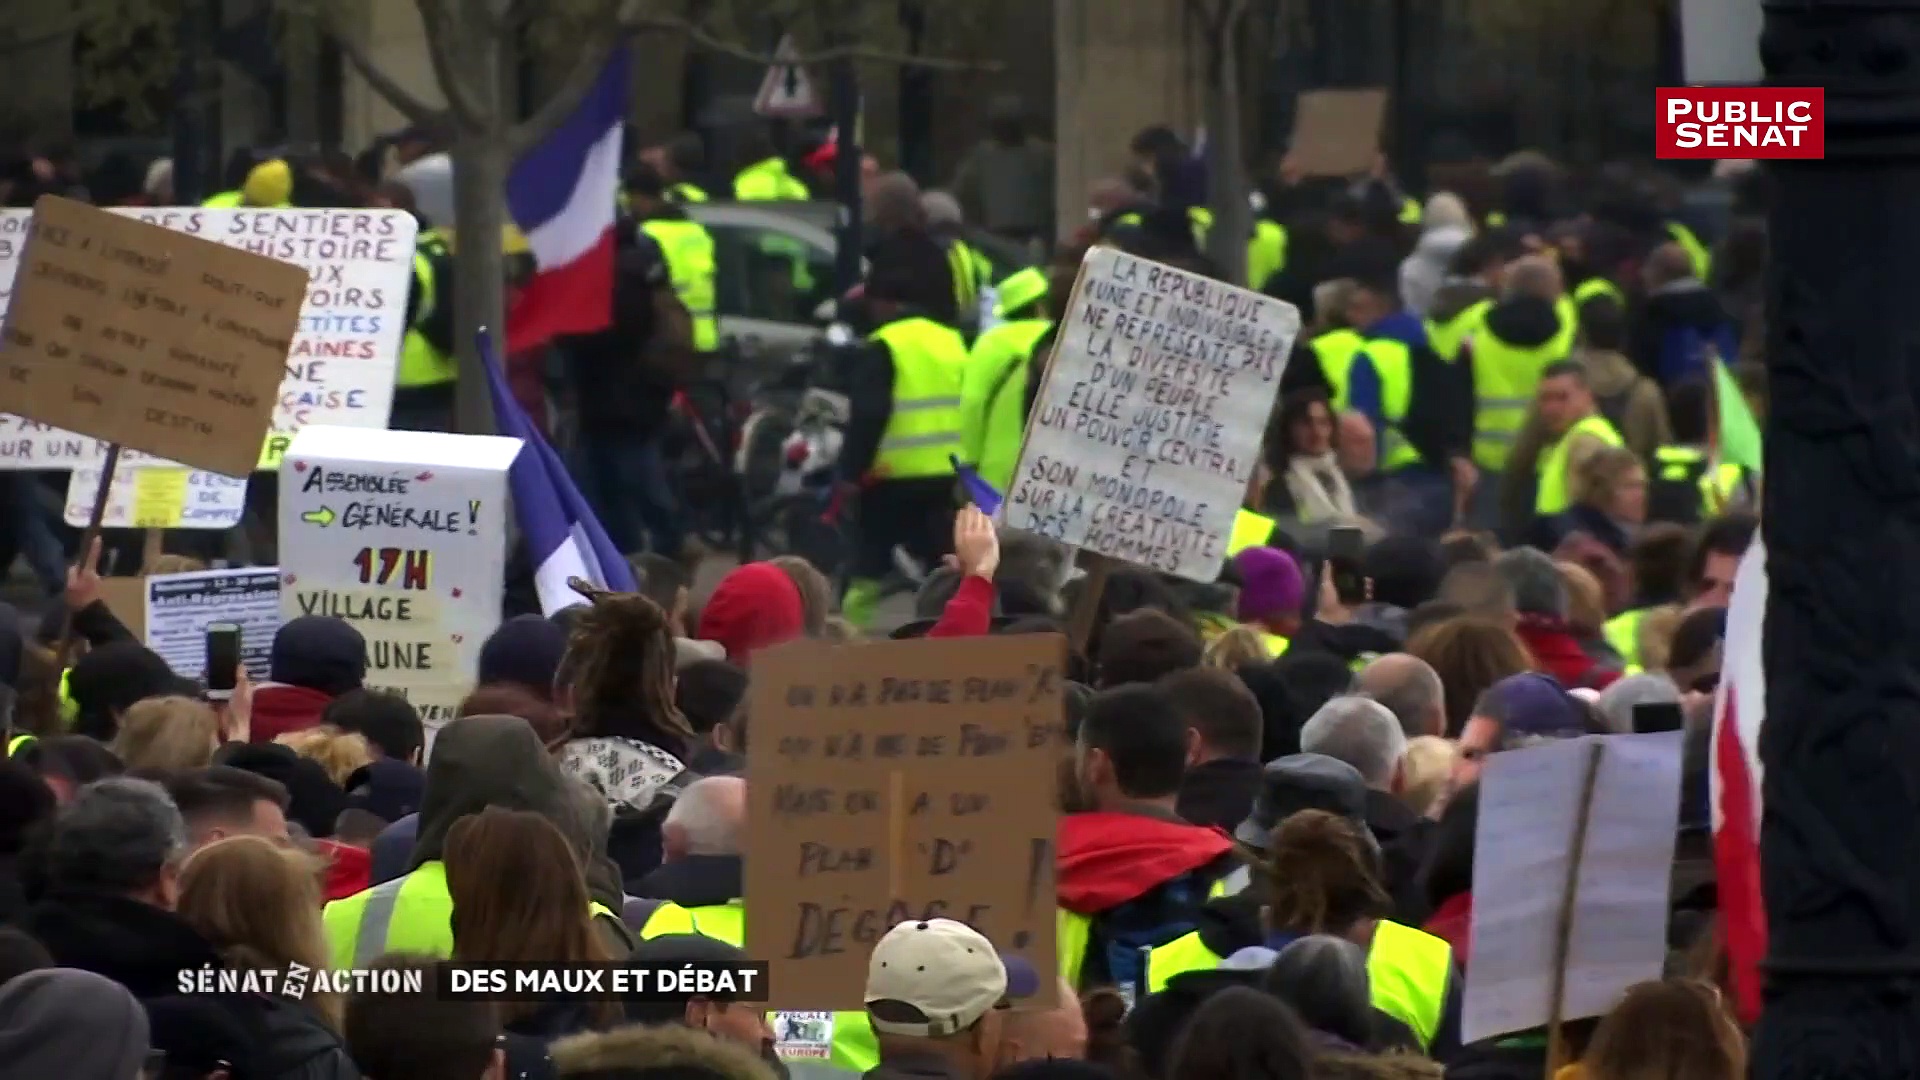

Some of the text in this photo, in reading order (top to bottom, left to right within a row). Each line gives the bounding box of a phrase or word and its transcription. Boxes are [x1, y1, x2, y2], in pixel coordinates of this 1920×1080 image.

[229, 209, 394, 235] SENTIERS
[1112, 255, 1137, 281] LA
[311, 287, 384, 309] OIRS
[1134, 291, 1163, 318] ET
[295, 336, 376, 359] AINES
[1083, 304, 1109, 330] NE
[1241, 348, 1280, 382] PAS
[1087, 334, 1112, 361] LA
[1145, 377, 1219, 417] PEUPLE
[1068, 381, 1225, 449] ELLE JUSTIFIE
[47, 439, 81, 457] UN
[1040, 405, 1069, 431] UN
[1158, 438, 1245, 484] CENTRAL
[1121, 454, 1156, 483] ET
[1014, 479, 1055, 507] SUR
[1058, 493, 1084, 519] LA
[1030, 455, 1208, 527] SON MONOPOLE
[1027, 511, 1182, 572] DES HOMMES
[353, 547, 432, 590] 17H
[297, 590, 413, 621] VILLAGE
[799, 841, 876, 877] PLAN
